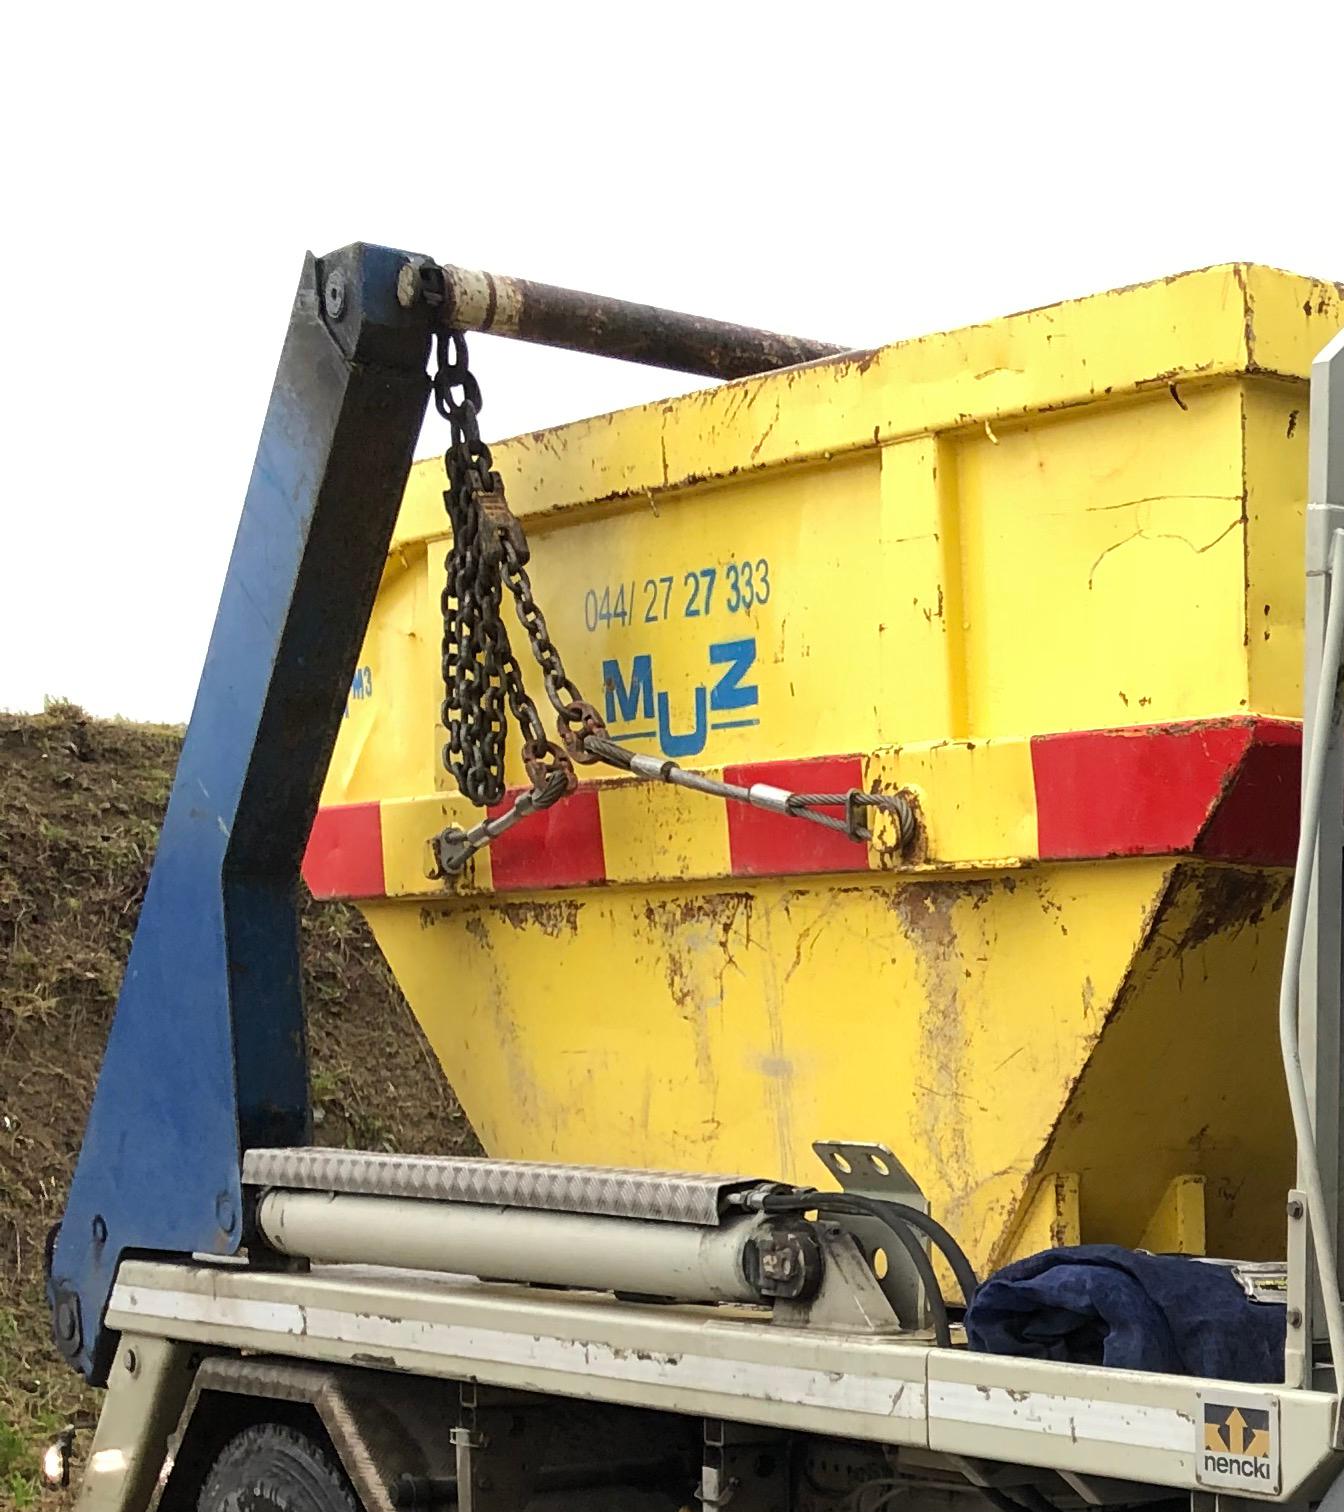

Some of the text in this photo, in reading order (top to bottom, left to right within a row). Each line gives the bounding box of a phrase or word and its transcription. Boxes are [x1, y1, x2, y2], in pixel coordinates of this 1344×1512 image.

[643, 575, 674, 624] 27
[684, 567, 717, 617] 27
[726, 558, 770, 614] 333
[1204, 1454, 1271, 1480] nencki
